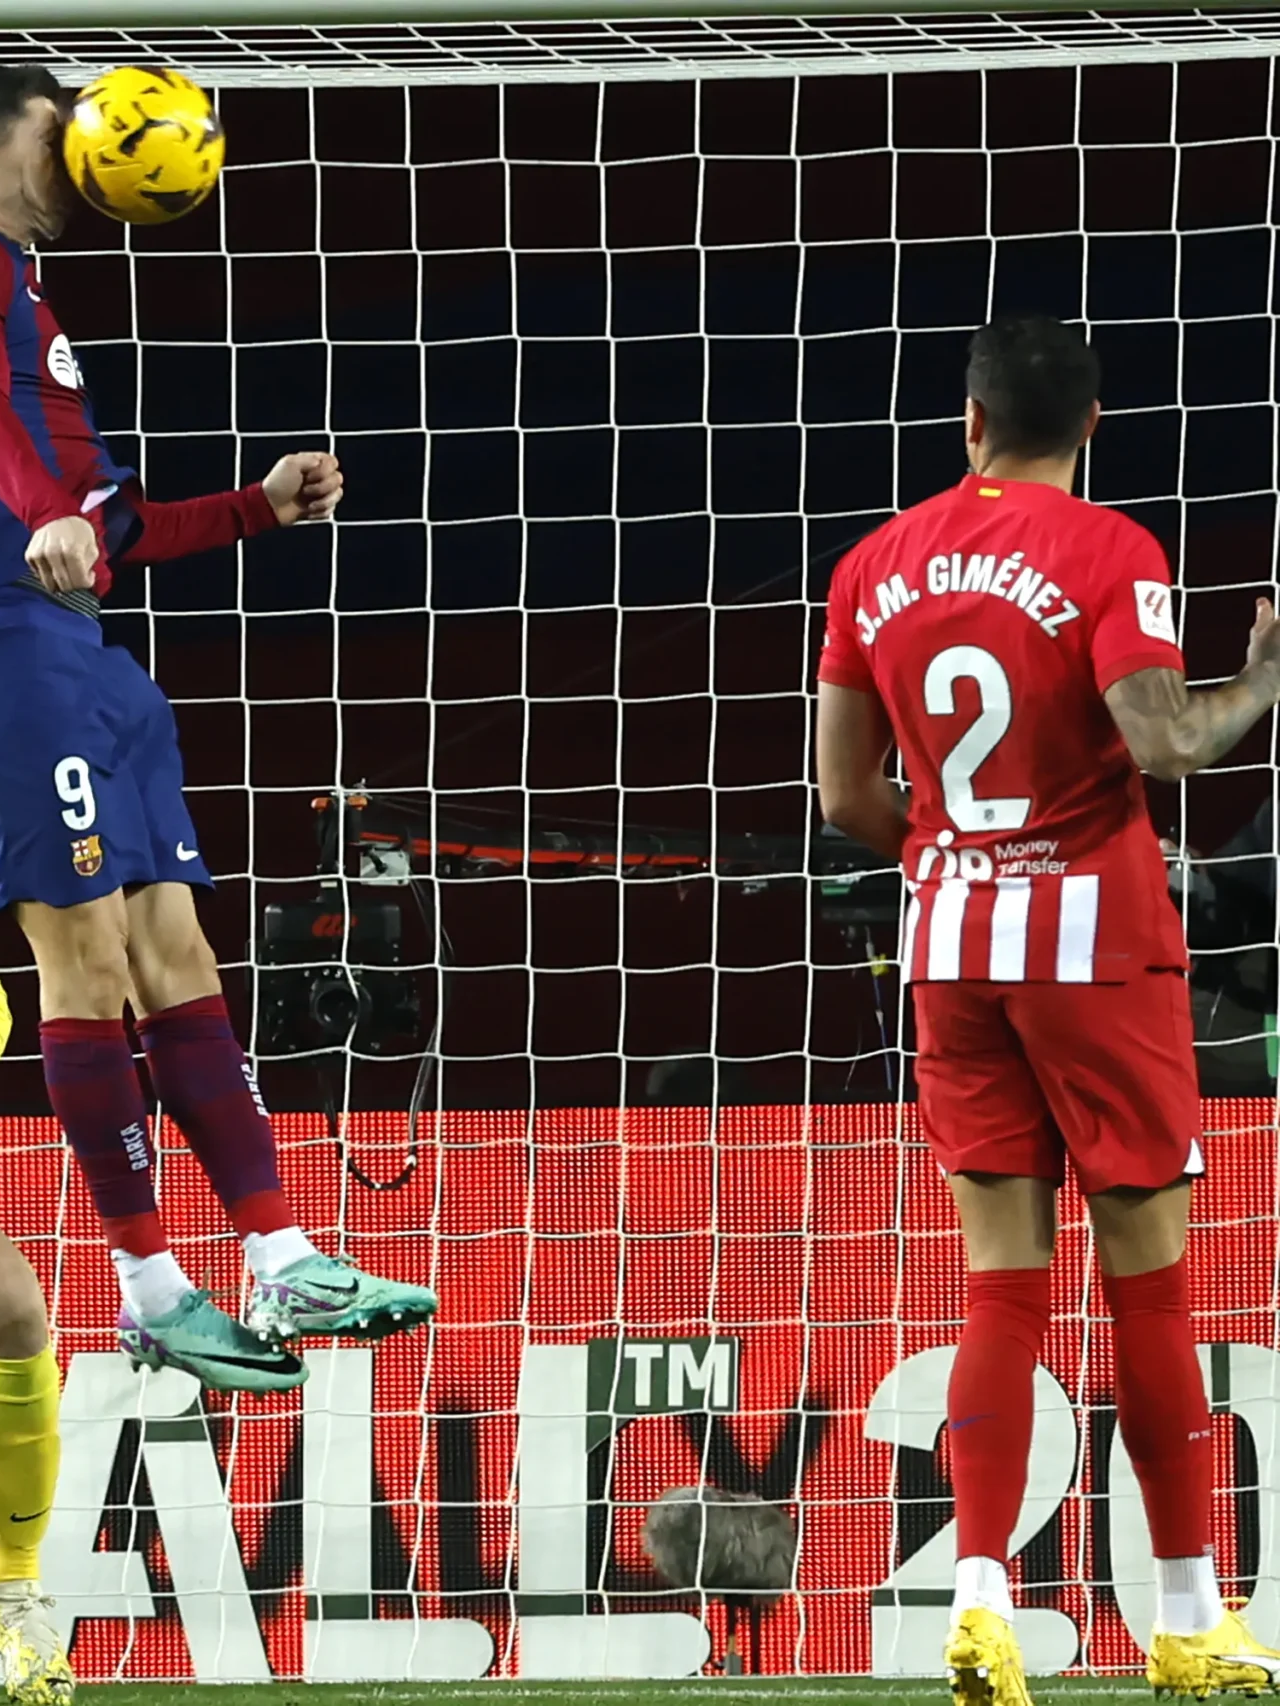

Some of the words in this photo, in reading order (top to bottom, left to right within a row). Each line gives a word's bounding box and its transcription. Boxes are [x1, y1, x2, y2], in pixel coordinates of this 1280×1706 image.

[855, 573, 921, 646] J.M.
[927, 551, 1081, 638] GIMÉNEZ
[923, 644, 1031, 833] 2
[53, 756, 97, 832] 9
[916, 829, 993, 882] ria
[994, 840, 1059, 860] Money
